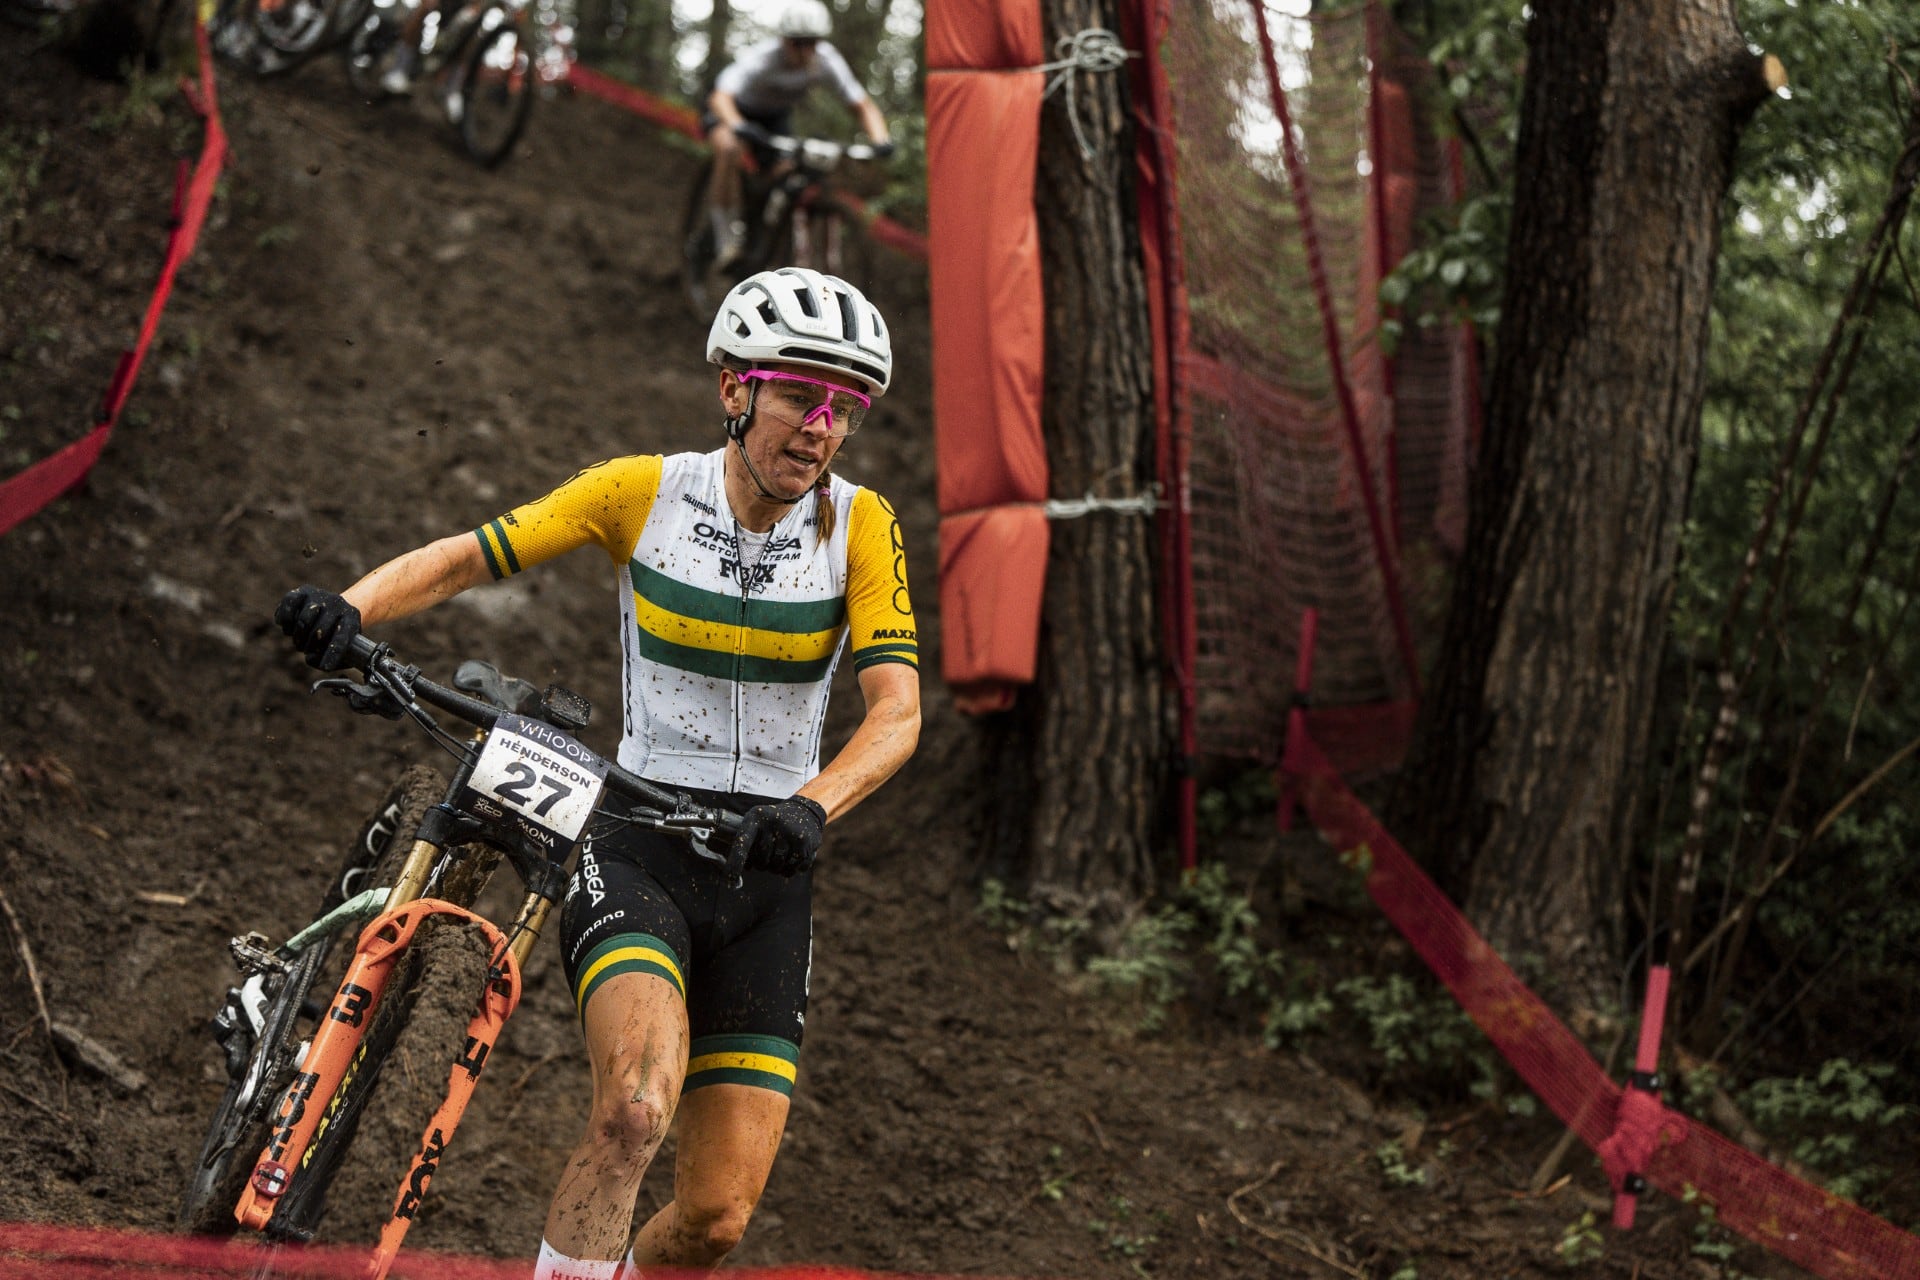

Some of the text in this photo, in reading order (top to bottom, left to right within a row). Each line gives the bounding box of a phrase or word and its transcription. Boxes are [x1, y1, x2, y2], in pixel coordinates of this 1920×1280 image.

[768, 552, 801, 561] TEAM
[872, 629, 916, 640] MAXX
[520, 720, 593, 763] WHOOP
[500, 738, 591, 789] HENDERSON
[493, 761, 573, 818] 27
[474, 801, 503, 818] XCO
[521, 822, 555, 848] MONA
